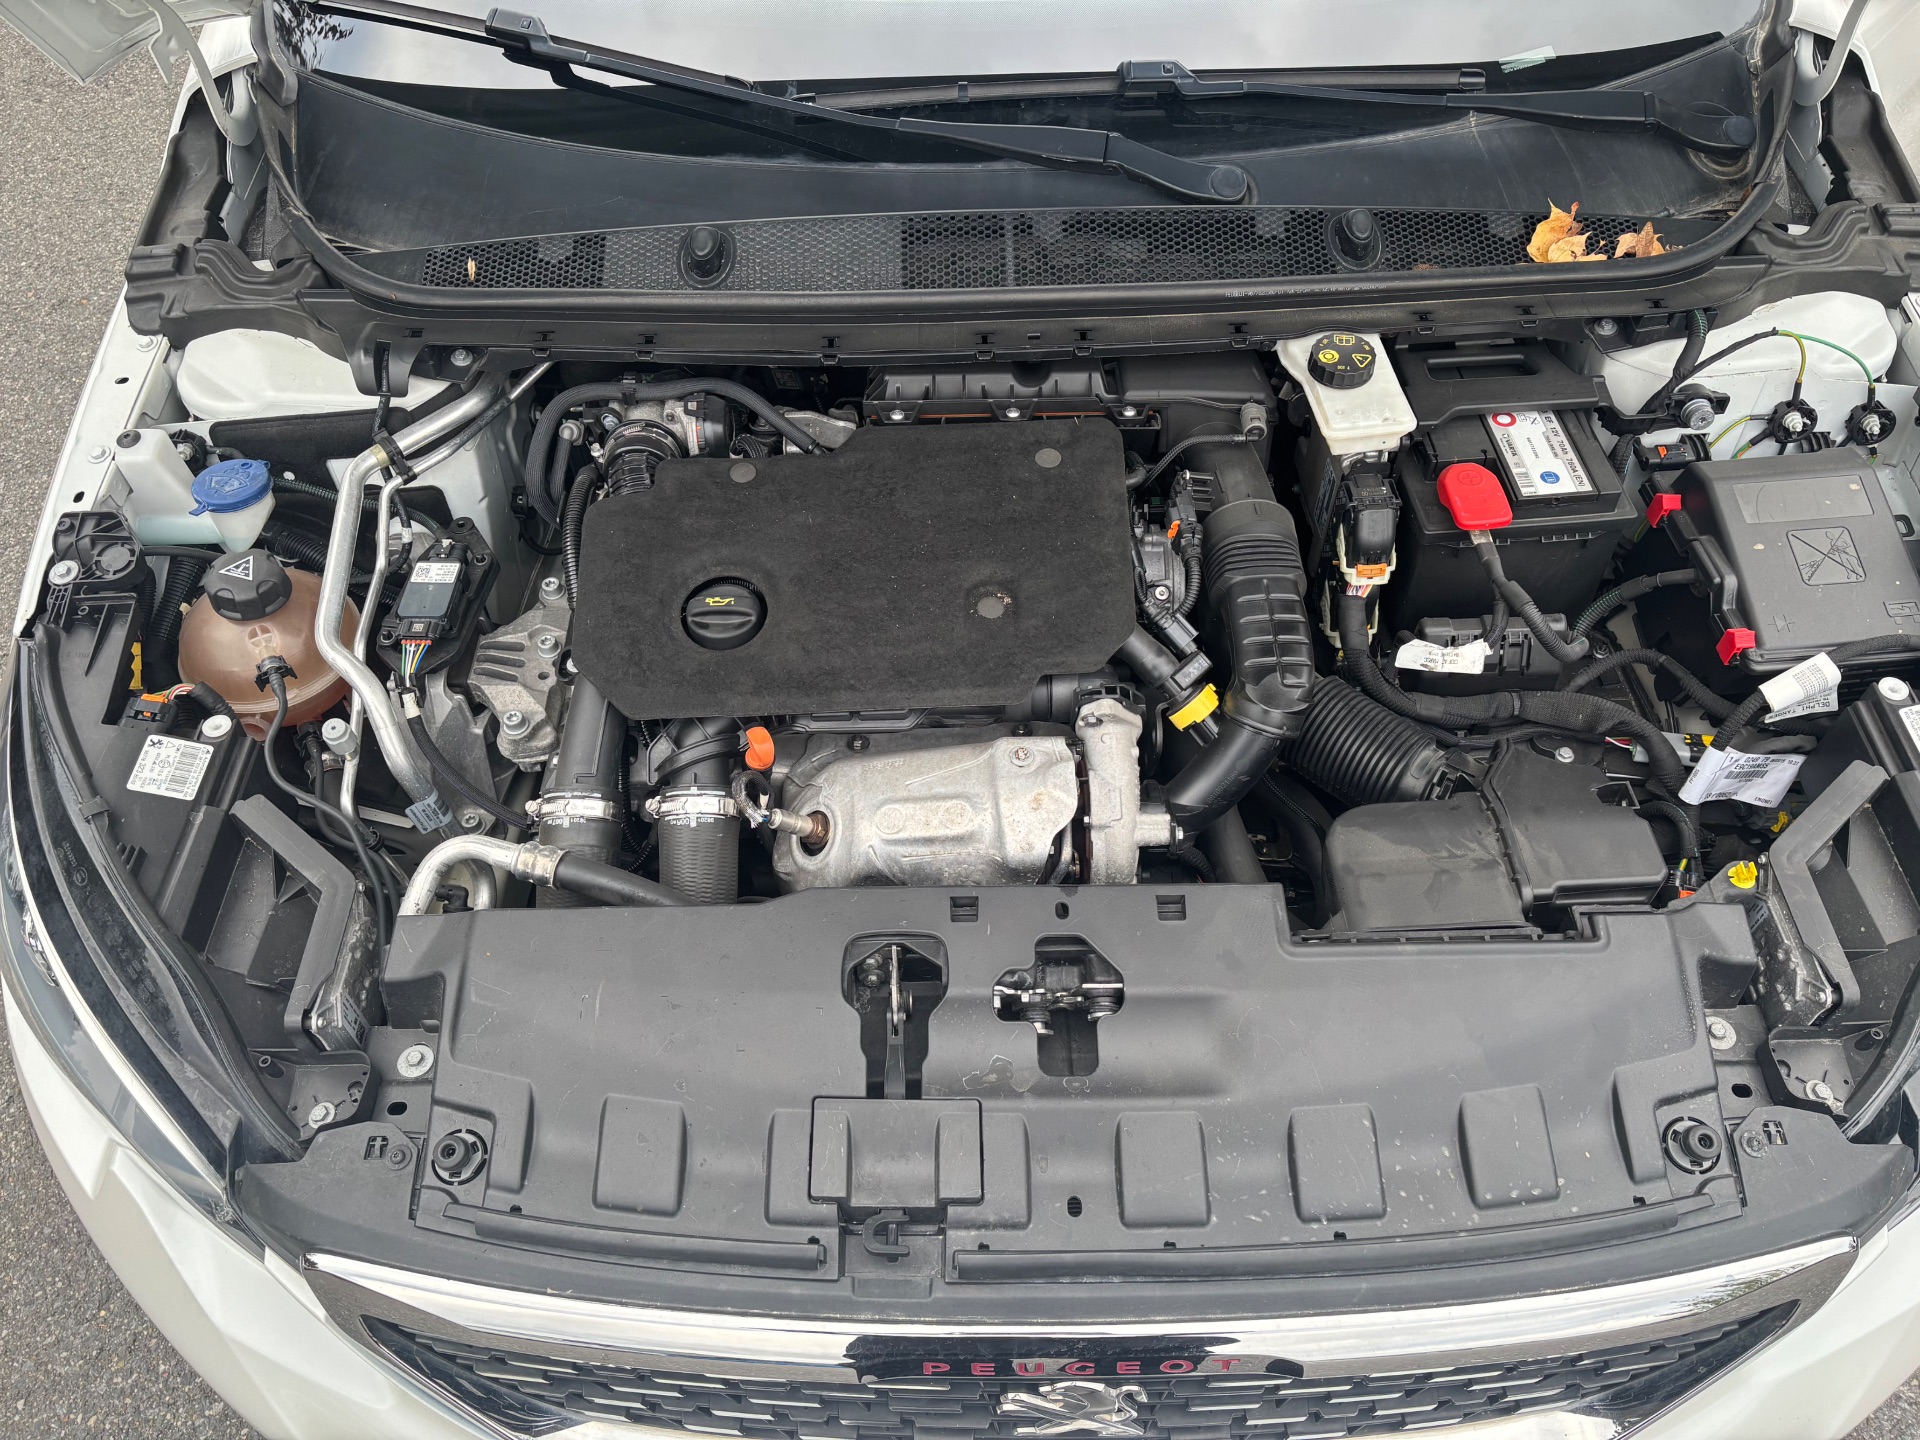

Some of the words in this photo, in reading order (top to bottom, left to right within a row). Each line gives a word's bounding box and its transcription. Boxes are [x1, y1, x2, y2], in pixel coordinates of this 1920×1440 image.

[1505, 438, 1517, 457] VARTA
[1550, 427, 1561, 437] 12V
[1557, 440, 1568, 456] 70Ah
[1573, 474, 1585, 487] (EN)
[1802, 701, 1830, 711] DELPHI
[922, 1358, 1240, 1377] PEUGEOT
